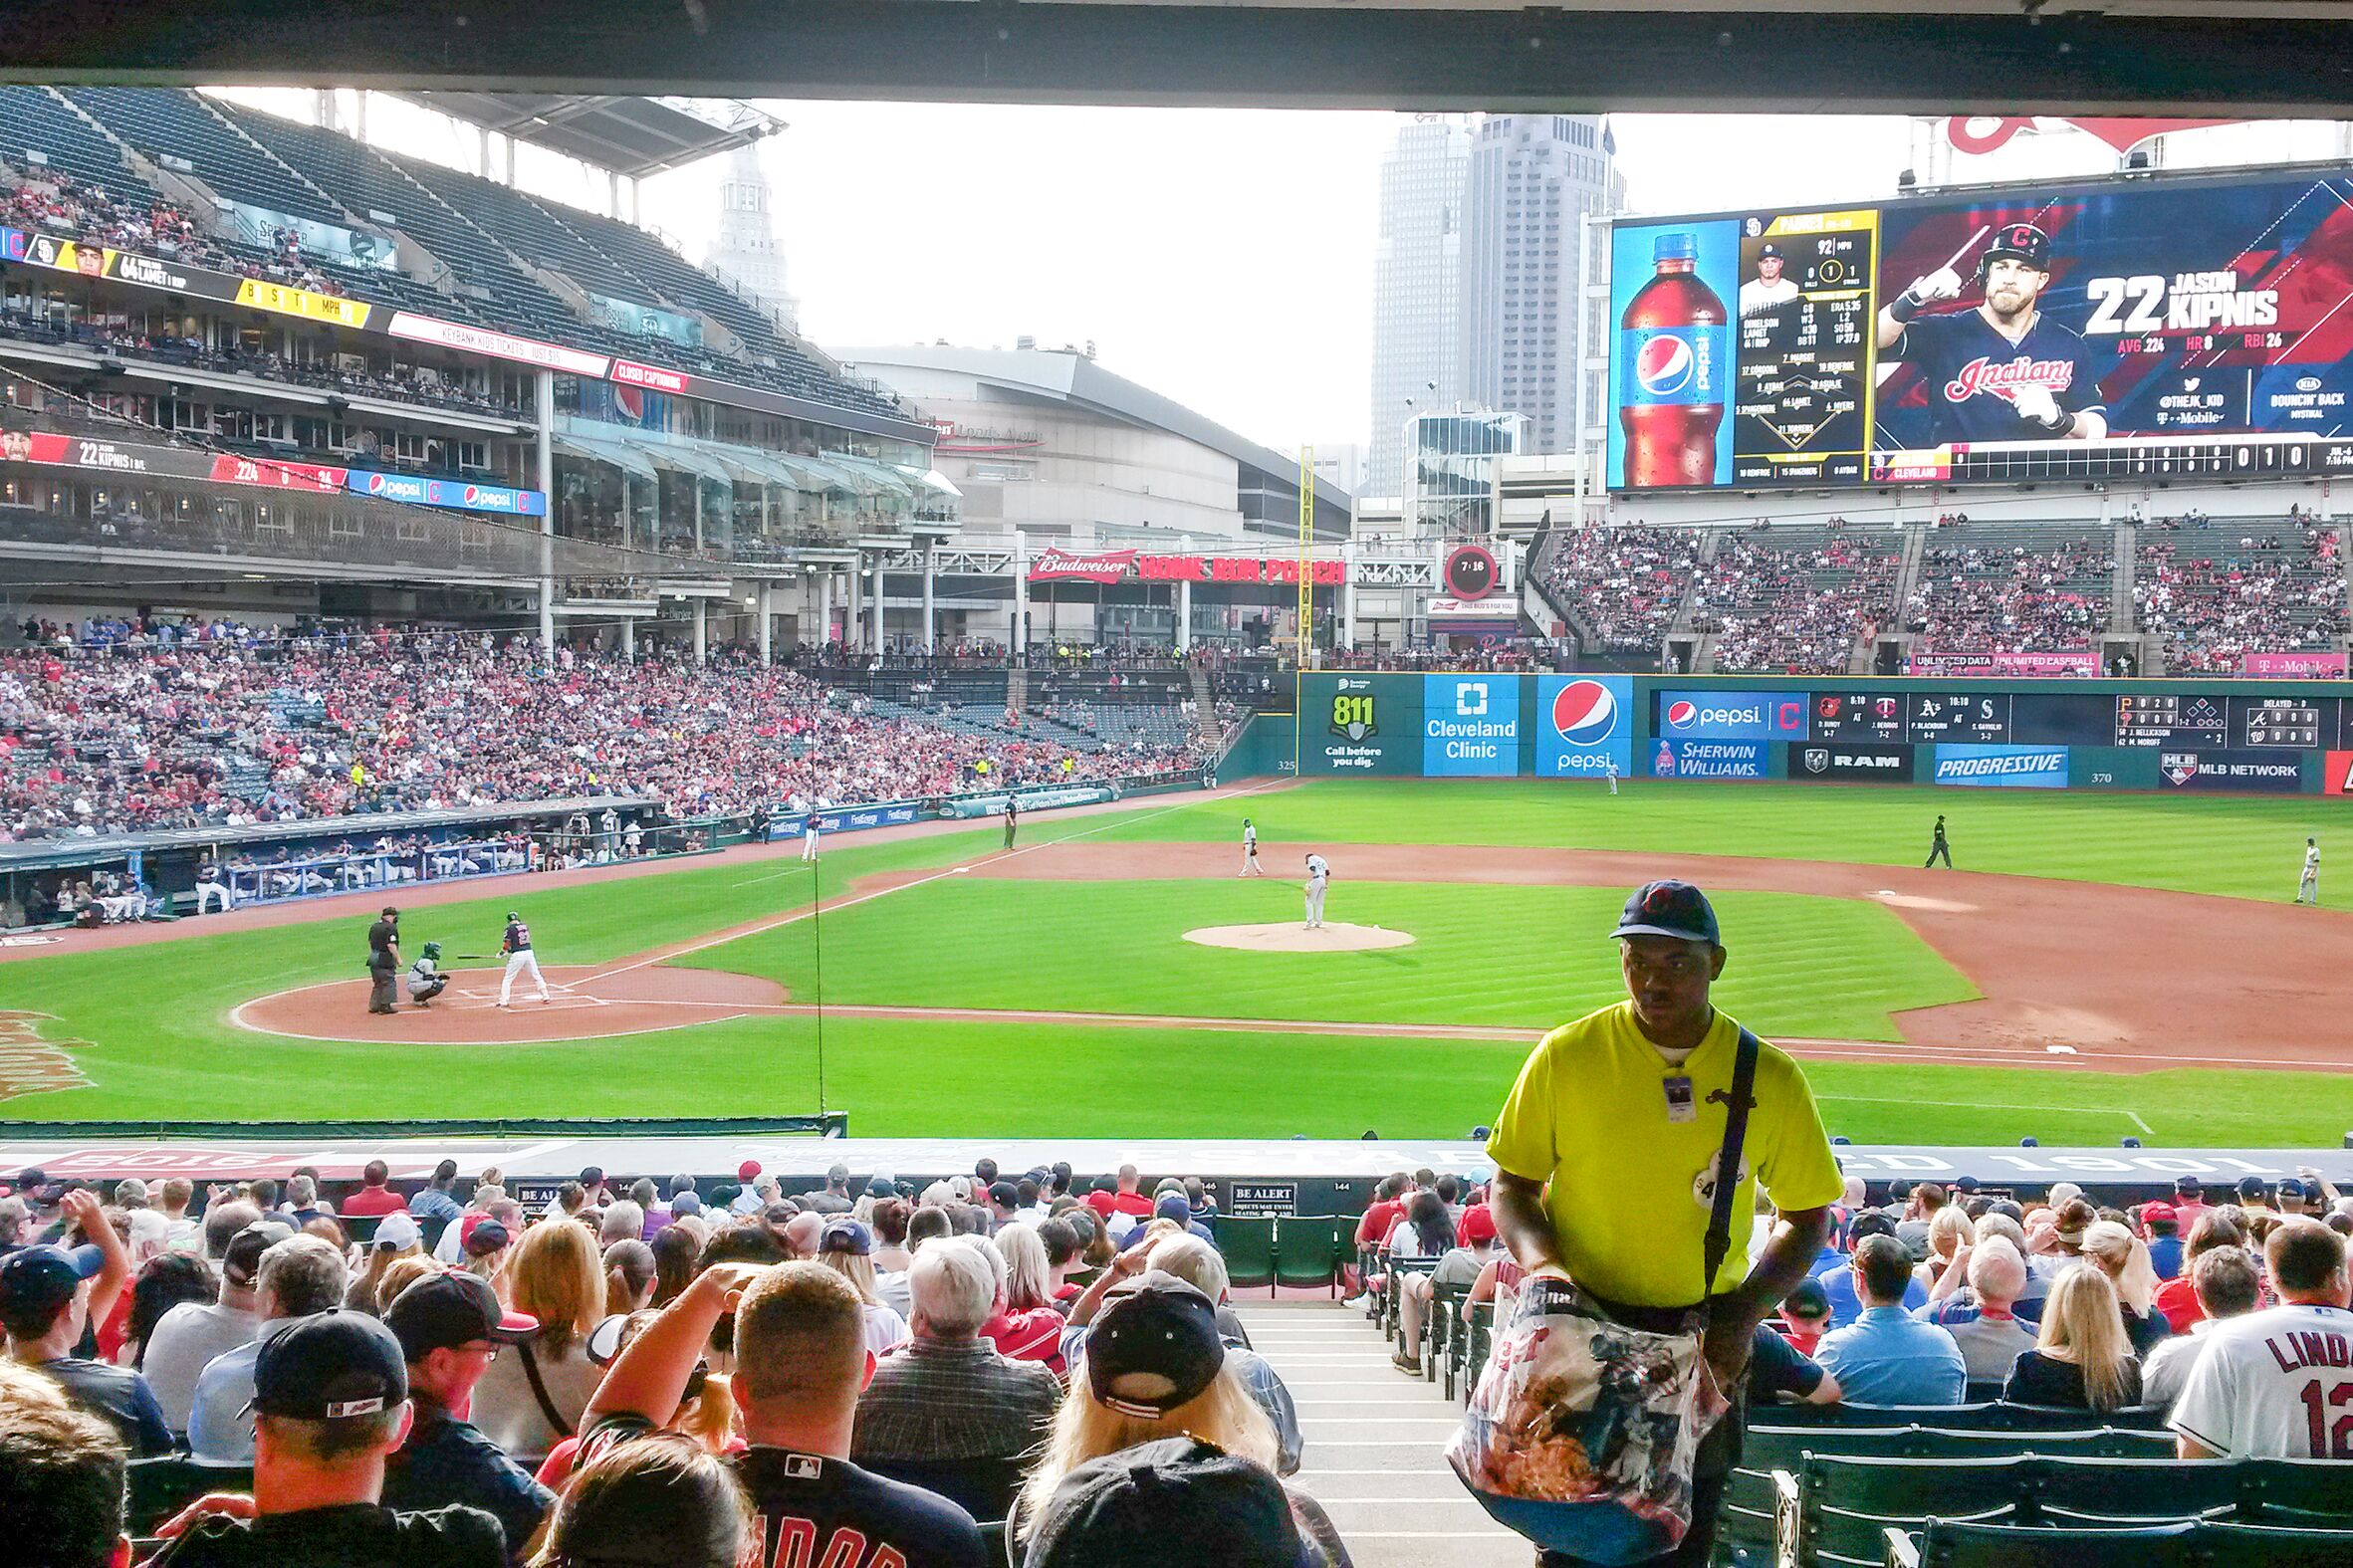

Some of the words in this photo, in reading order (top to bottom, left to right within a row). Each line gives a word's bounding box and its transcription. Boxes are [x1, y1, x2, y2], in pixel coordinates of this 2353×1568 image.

[9, 234, 25, 256] C
[2011, 228, 2031, 247] C
[1818, 239, 1832, 255] 92
[120, 255, 138, 280] 64
[138, 266, 168, 286] LAMET
[1828, 265, 1833, 277] 1
[2169, 271, 2236, 295] JASON
[248, 284, 254, 297] B
[272, 289, 278, 302] S
[323, 300, 340, 315] MPH
[2085, 275, 2166, 335] 22
[2168, 290, 2278, 330] KIPNIS
[478, 336, 495, 349] KIDS
[2118, 338, 2141, 353] AVG
[2143, 337, 2165, 353] .224
[2187, 336, 2204, 350] HR
[2204, 336, 2213, 350] 8
[2244, 334, 2264, 348] RBI
[2266, 333, 2282, 347] 26
[1695, 336, 1712, 390] pepsi
[618, 364, 644, 382] CLOSED
[2270, 394, 2316, 407] BOUNCIN'
[2318, 393, 2345, 406] BACK
[80, 442, 98, 465] 22
[99, 452, 129, 468] KIPNIS
[2164, 447, 2170, 458] 0
[2189, 446, 2195, 457] 0
[2214, 446, 2221, 456] 0
[2238, 447, 2249, 467] 0
[2265, 447, 2273, 466] 1
[2291, 447, 2302, 466] 0
[2326, 456, 2342, 466] 7:16
[234, 462, 258, 481] .224
[1894, 468, 1937, 479] CLEVELAND
[387, 481, 420, 498] pepsi
[429, 483, 440, 503] C
[480, 492, 510, 508] pepsi
[518, 493, 529, 512] C
[1037, 551, 1128, 575] Budweiser
[1139, 555, 1206, 581] HOME
[1212, 558, 1260, 582] RUN
[1462, 561, 1485, 571] 7:16
[1917, 656, 1967, 666] UNLIMTED
[1967, 656, 1992, 666] DATA
[1995, 656, 2045, 666] UNLIMITED
[2047, 657, 2095, 666] BASEBALL
[1333, 695, 1374, 726] 811
[2155, 698, 2160, 708] 2
[1779, 703, 1800, 730] C
[1853, 713, 1862, 722] AT
[1954, 714, 1963, 724] AT
[1427, 720, 1517, 739] Cleveland
[2217, 734, 2222, 743] 2
[1325, 747, 1345, 757] Call
[1346, 747, 1381, 757] before
[1446, 741, 1497, 759] Clinic
[1682, 742, 1757, 759] SHERWIN
[1278, 761, 1295, 771] 325
[1332, 757, 1353, 769] you
[1354, 757, 1374, 769] dig.
[1558, 752, 1611, 771] pepsi
[1834, 756, 1900, 768] RAM
[1937, 754, 2062, 778] PROGRESSIVE
[2164, 755, 2195, 765] MLB
[2091, 773, 2112, 784] 370
[2199, 764, 2227, 775] MLB
[2231, 765, 2297, 777] NETWORK
[58, 1155, 263, 1167] 2016
[1989, 1154, 2285, 1174] 1901
[521, 1190, 538, 1201] BE
[1236, 1189, 1251, 1199] BE
[1254, 1189, 1293, 1199] ALERT
[2265, 1331, 2353, 1374] LIND
[2300, 1379, 2353, 1458] 12
